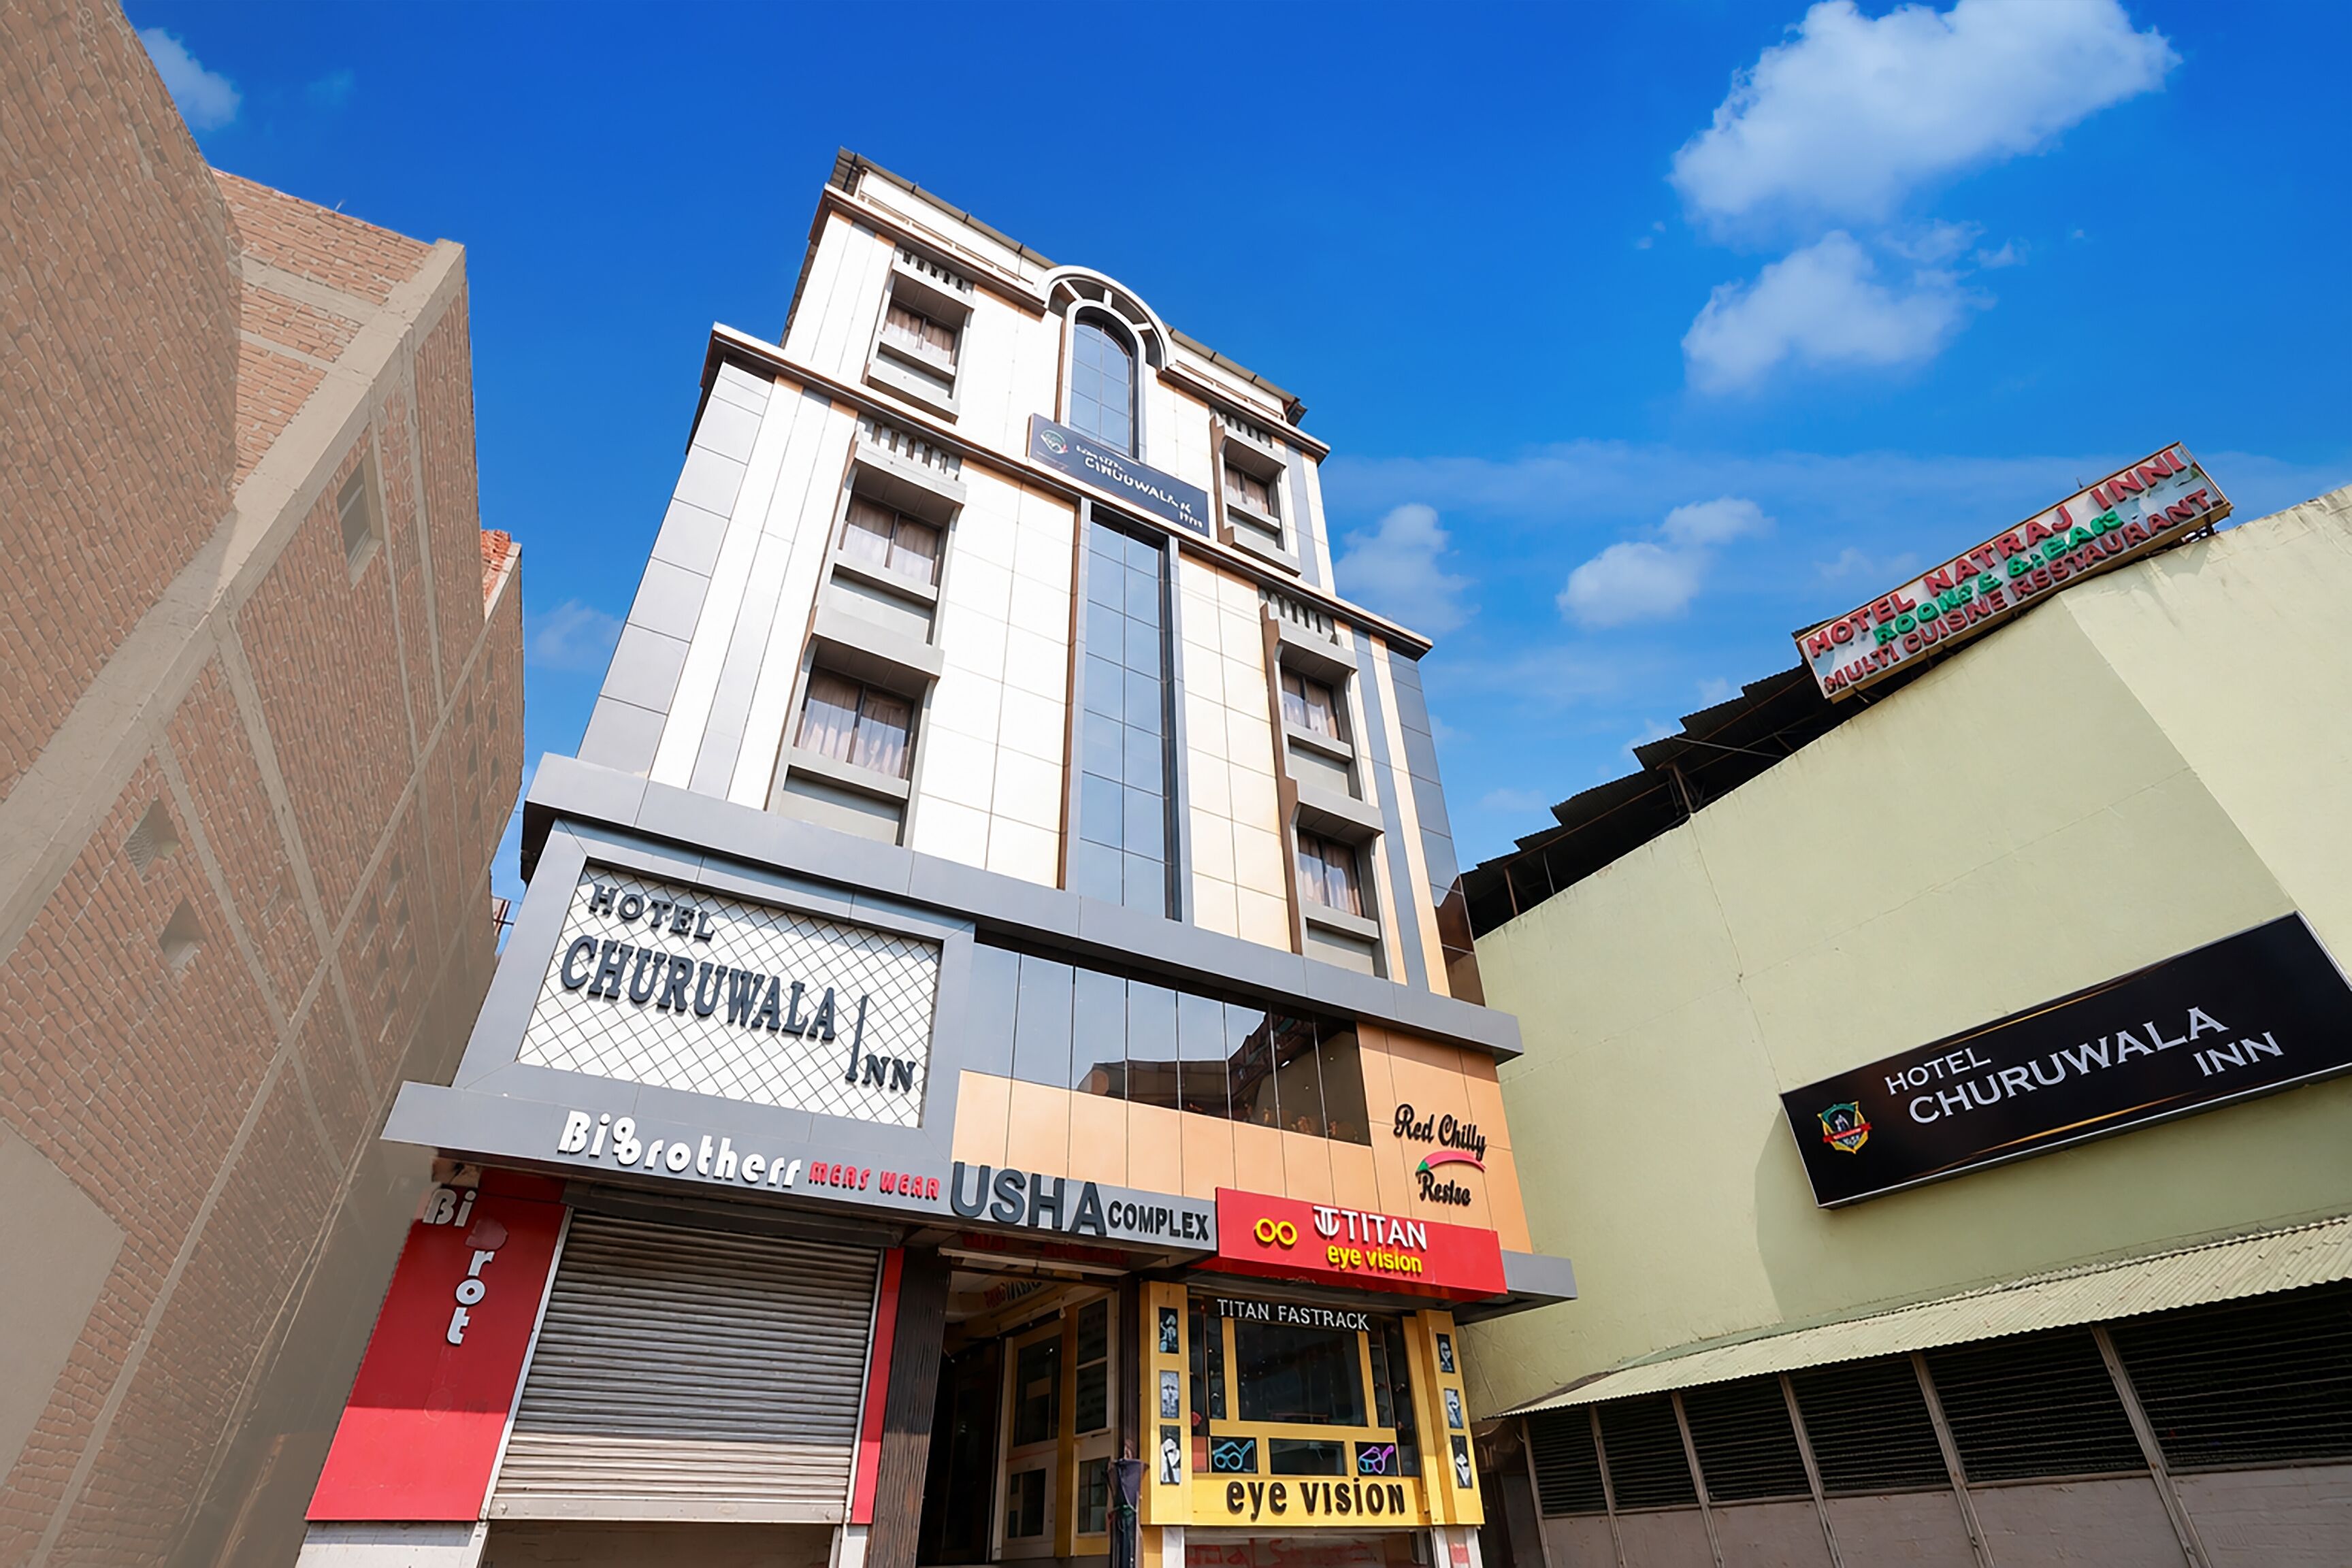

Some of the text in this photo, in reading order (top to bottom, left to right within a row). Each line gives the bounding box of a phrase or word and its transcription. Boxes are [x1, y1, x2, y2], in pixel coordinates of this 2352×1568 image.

[1806, 592, 1916, 659] HOTEL
[1923, 504, 2073, 598] NATRAJ
[1824, 642, 1900, 694] MULTI
[2008, 487, 2210, 602] RESTAURANT
[588, 882, 715, 943] HOTEL
[560, 934, 837, 1041] CHURUWALA
[845, 994, 917, 1093] INN
[1884, 1046, 1993, 1096] HOTEL
[1908, 1005, 2230, 1125] CHURUWALA
[2192, 1030, 2285, 1078] INN
[1392, 1103, 1488, 1163] Red Chilly
[879, 1170, 941, 1201] WEAR
[950, 1161, 1210, 1242] USHA COMPLEX
[1327, 1245, 1423, 1275] eye vision
[1341, 1210, 1428, 1251] TITAN
[1217, 1298, 1371, 1332] TITAN FASTRACK
[1226, 1477, 1406, 1522] eye vision
